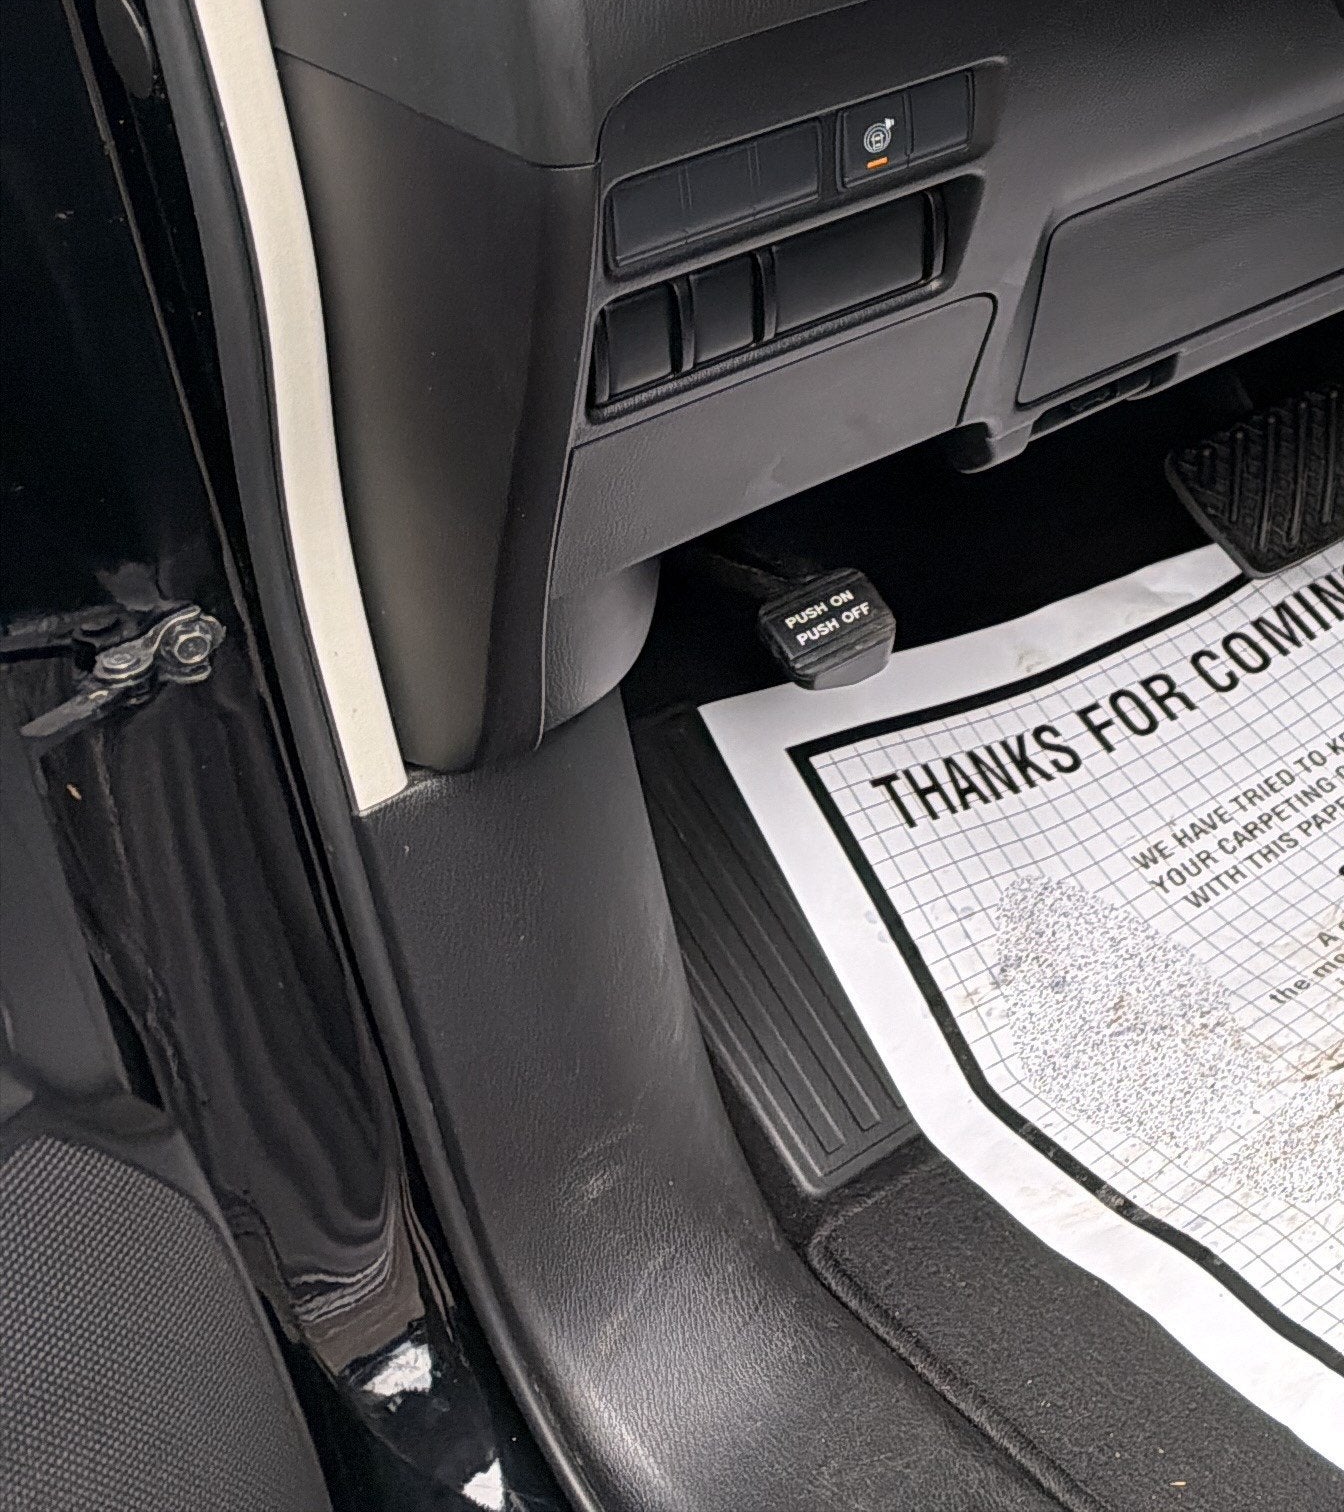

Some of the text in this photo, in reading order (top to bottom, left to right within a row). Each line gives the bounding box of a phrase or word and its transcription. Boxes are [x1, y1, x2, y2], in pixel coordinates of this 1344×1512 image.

[784, 589, 855, 630] PUSH ON
[795, 601, 871, 646] PUSH OFF
[870, 724, 1082, 828] THANKS
[1075, 672, 1200, 754] FOR
[1131, 839, 1176, 871] WE
[1171, 804, 1235, 849] HAVE
[1229, 768, 1297, 813] TRIED
[1293, 749, 1328, 774] TO
[1149, 849, 1219, 895] YOUR
[1217, 776, 1337, 856] CARPETING
[1183, 864, 1249, 910] WITH
[1244, 831, 1300, 871] THIS
[1316, 930, 1339, 948] A
[1268, 979, 1312, 1005] the
